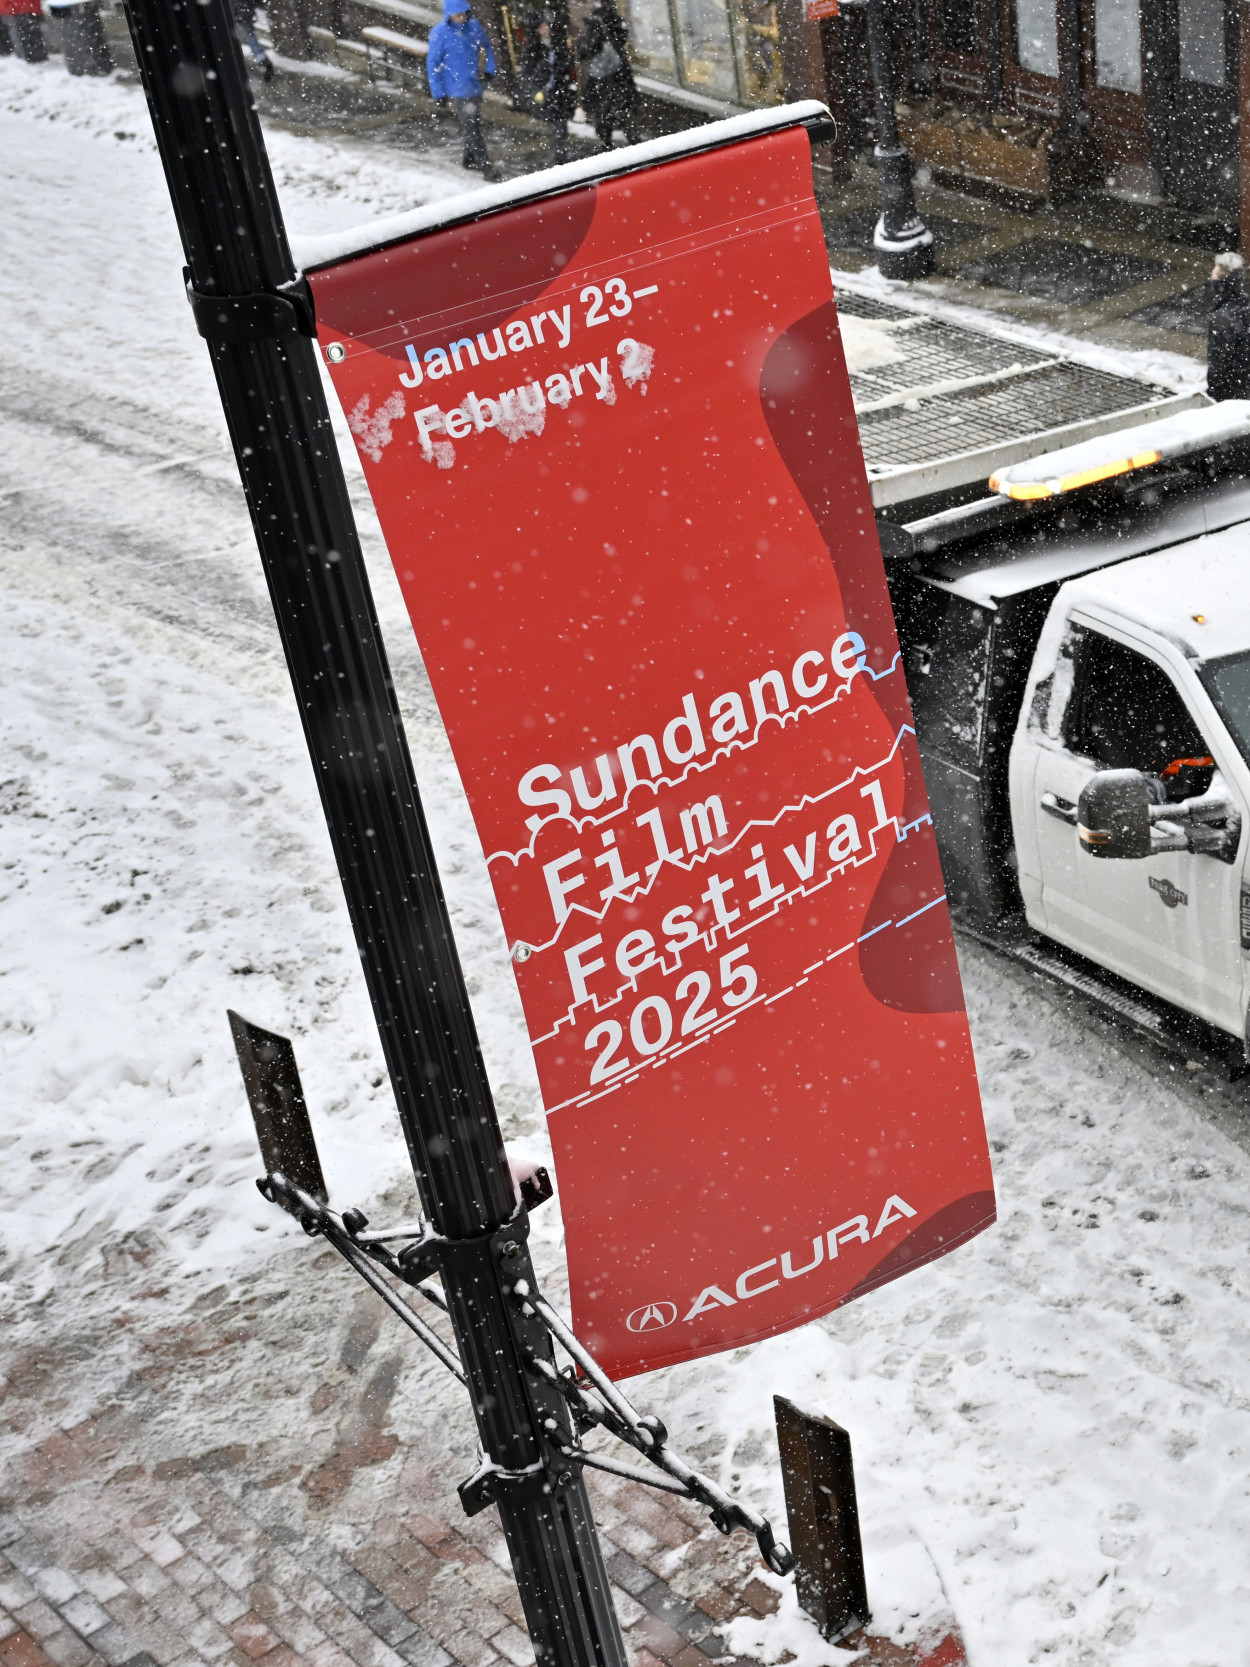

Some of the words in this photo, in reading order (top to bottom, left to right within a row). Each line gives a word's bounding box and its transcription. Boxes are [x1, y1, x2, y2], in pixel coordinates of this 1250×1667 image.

[398, 304, 571, 388] January
[413, 356, 609, 451] February
[616, 338, 648, 380] 2
[518, 631, 866, 832] Sundance
[542, 794, 728, 924] Film
[563, 779, 896, 1004] Festival
[584, 943, 758, 1085] 2025
[682, 1194, 918, 1322] ACURA
